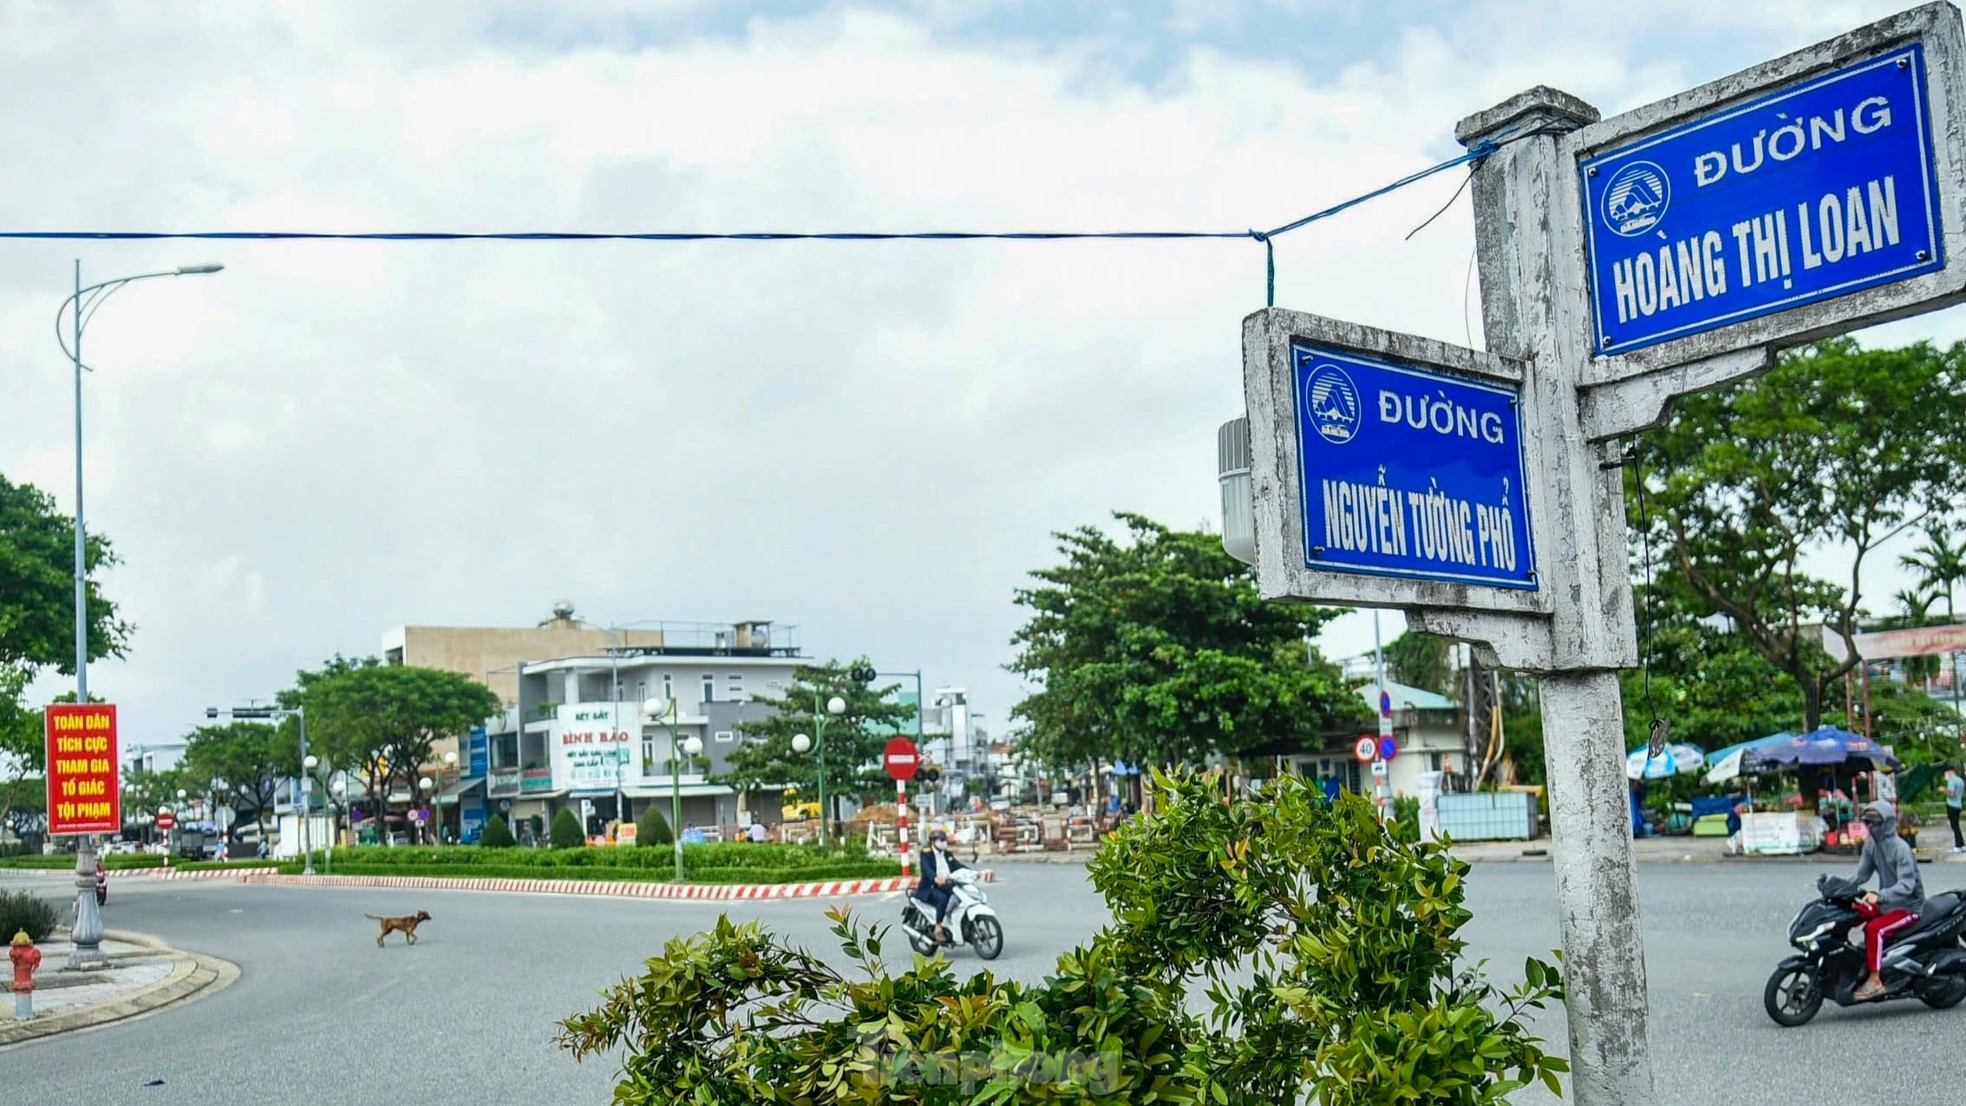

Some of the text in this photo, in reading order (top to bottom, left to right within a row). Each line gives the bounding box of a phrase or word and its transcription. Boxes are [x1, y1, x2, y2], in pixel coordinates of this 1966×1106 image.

[1694, 95, 1892, 187] ĐƯỜNG
[1613, 175, 1900, 324] HOÀNG THỊ LOAN
[1378, 389, 1504, 444] ĐƯỜNG
[1322, 464, 1516, 572] NGUYỄN TƯỜNG PHỔ
[53, 713, 110, 730] TOÀN DÂN
[56, 735, 108, 754] TÍCH CỰC
[1360, 743, 1372, 754] 40
[56, 758, 110, 775] THAM GIA
[61, 776, 105, 797] TỐ GIÁC
[57, 801, 110, 821] TỘI PHẠM
